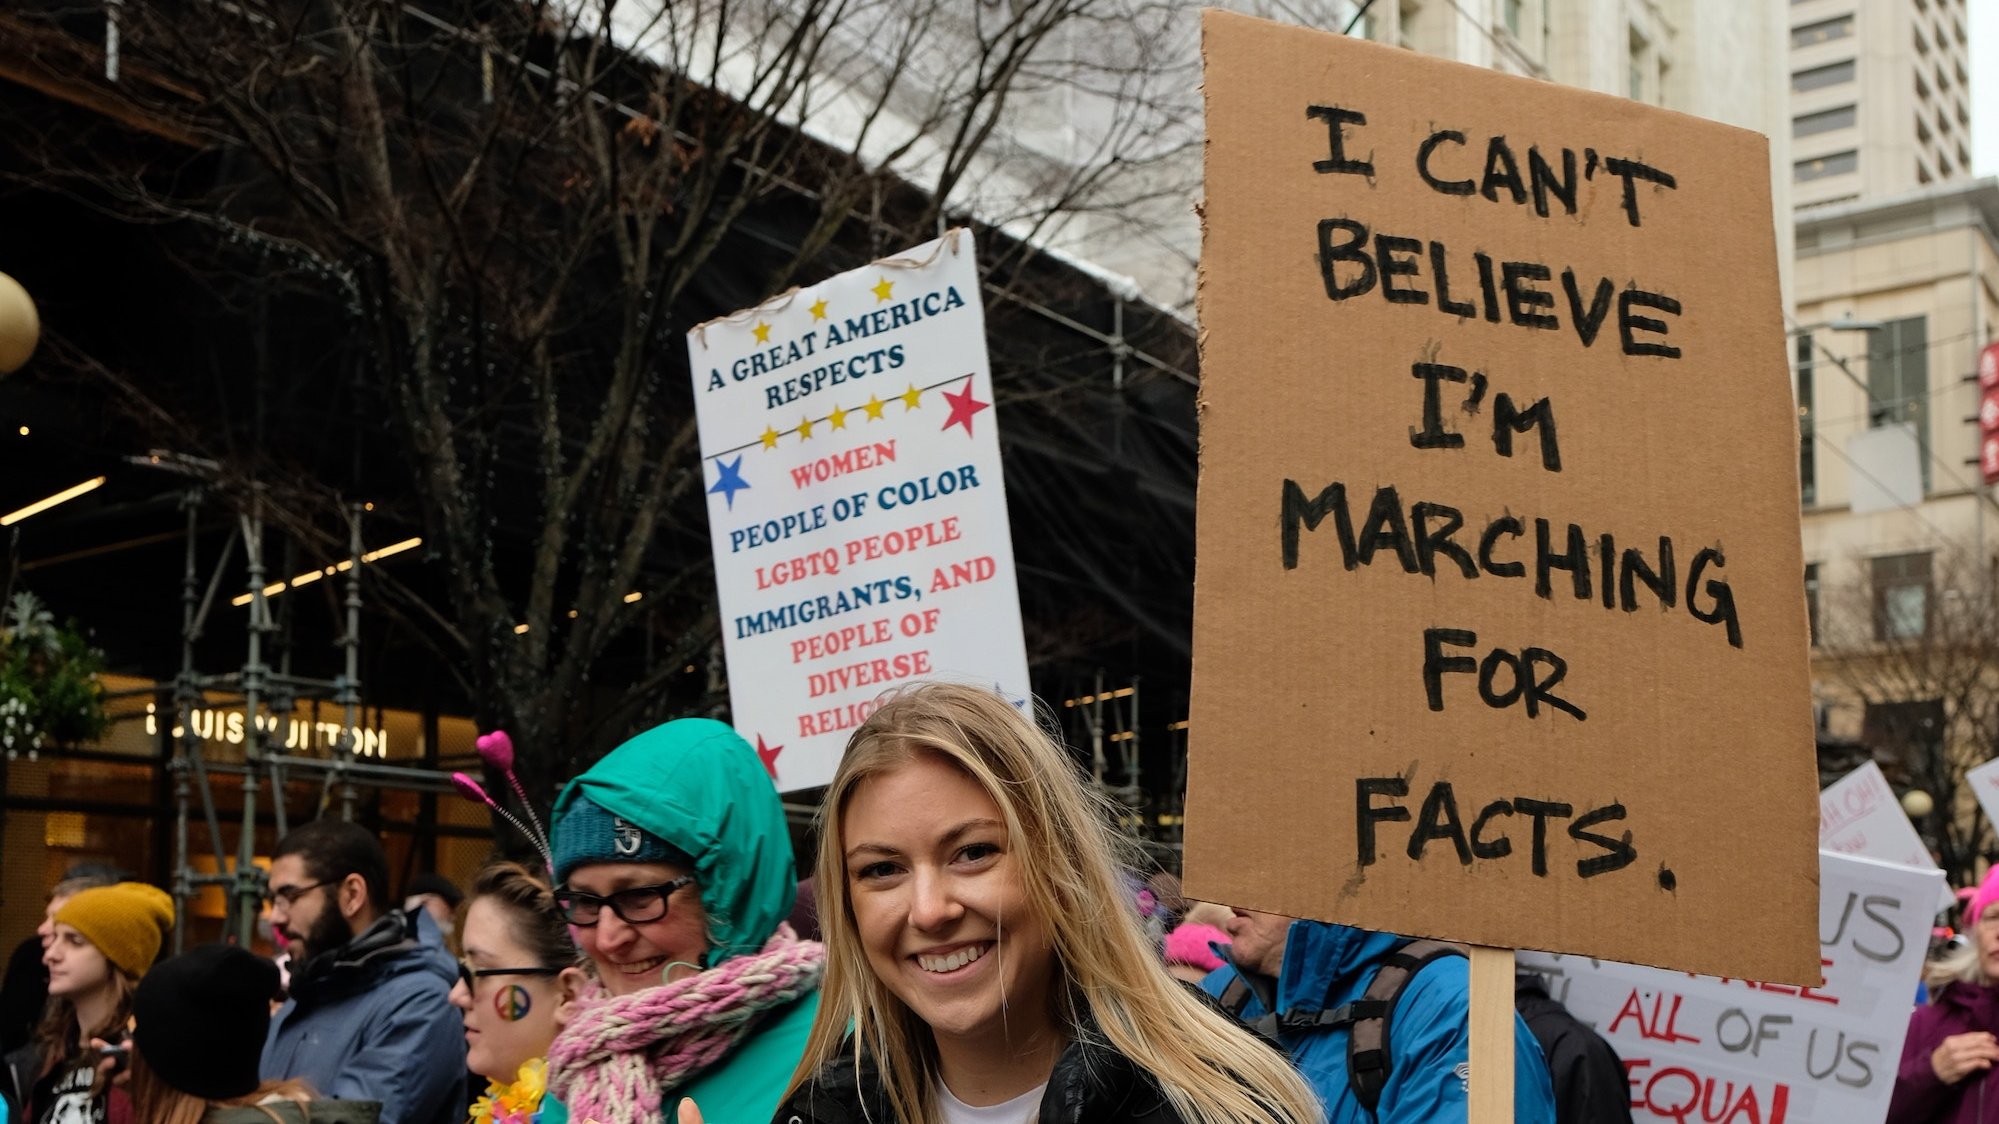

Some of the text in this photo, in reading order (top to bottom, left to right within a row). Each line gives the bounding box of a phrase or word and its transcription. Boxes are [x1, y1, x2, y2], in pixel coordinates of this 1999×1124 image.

[1306, 104, 1678, 227] I CAN'T
[1317, 217, 1681, 358] BELIEVE
[706, 285, 966, 392] A GREAT AMERICA
[764, 344, 906, 410] RESPECTS
[1410, 361, 1561, 472] I'M
[729, 463, 980, 553] PEOPLE OF COLOR
[790, 439, 897, 490] WOMEN
[734, 555, 997, 640] IMMIGRANTS, AND
[754, 516, 962, 591] LGBTQ PEOPLE
[1281, 478, 1743, 649] MARCHING
[790, 608, 941, 664] PEOPLE OF
[807, 650, 933, 698] DIVERSE
[1423, 628, 1587, 721] FOR
[146, 703, 245, 744] LUIS
[1356, 777, 1677, 892] FACTS.
[1608, 986, 1880, 1088] ALL OF US
